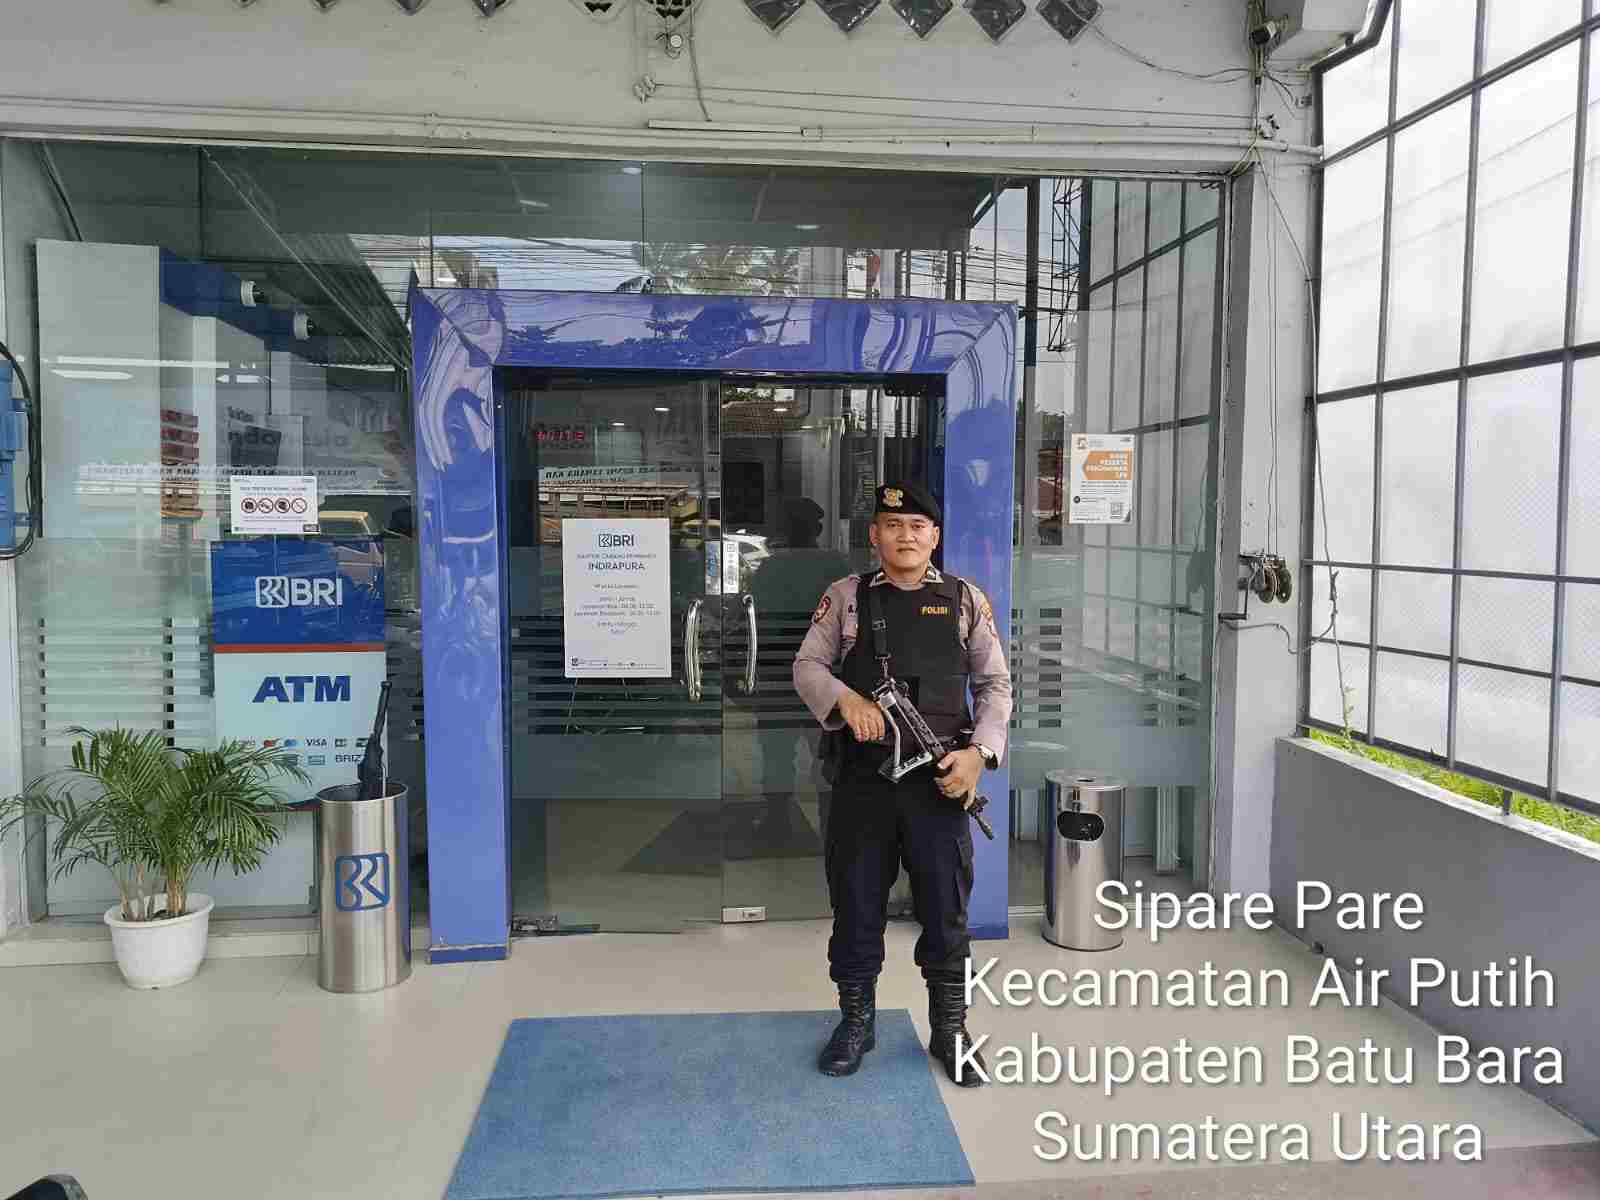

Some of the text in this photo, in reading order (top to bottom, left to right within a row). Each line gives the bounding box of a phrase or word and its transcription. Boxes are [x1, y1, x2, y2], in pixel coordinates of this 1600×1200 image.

[612, 535, 634, 547] BRI
[588, 561, 645, 570] INDRAPURA
[291, 578, 343, 606] BRI
[921, 606, 949, 615] POLISI
[253, 676, 350, 702] ATM
[306, 738, 328, 747] VISA
